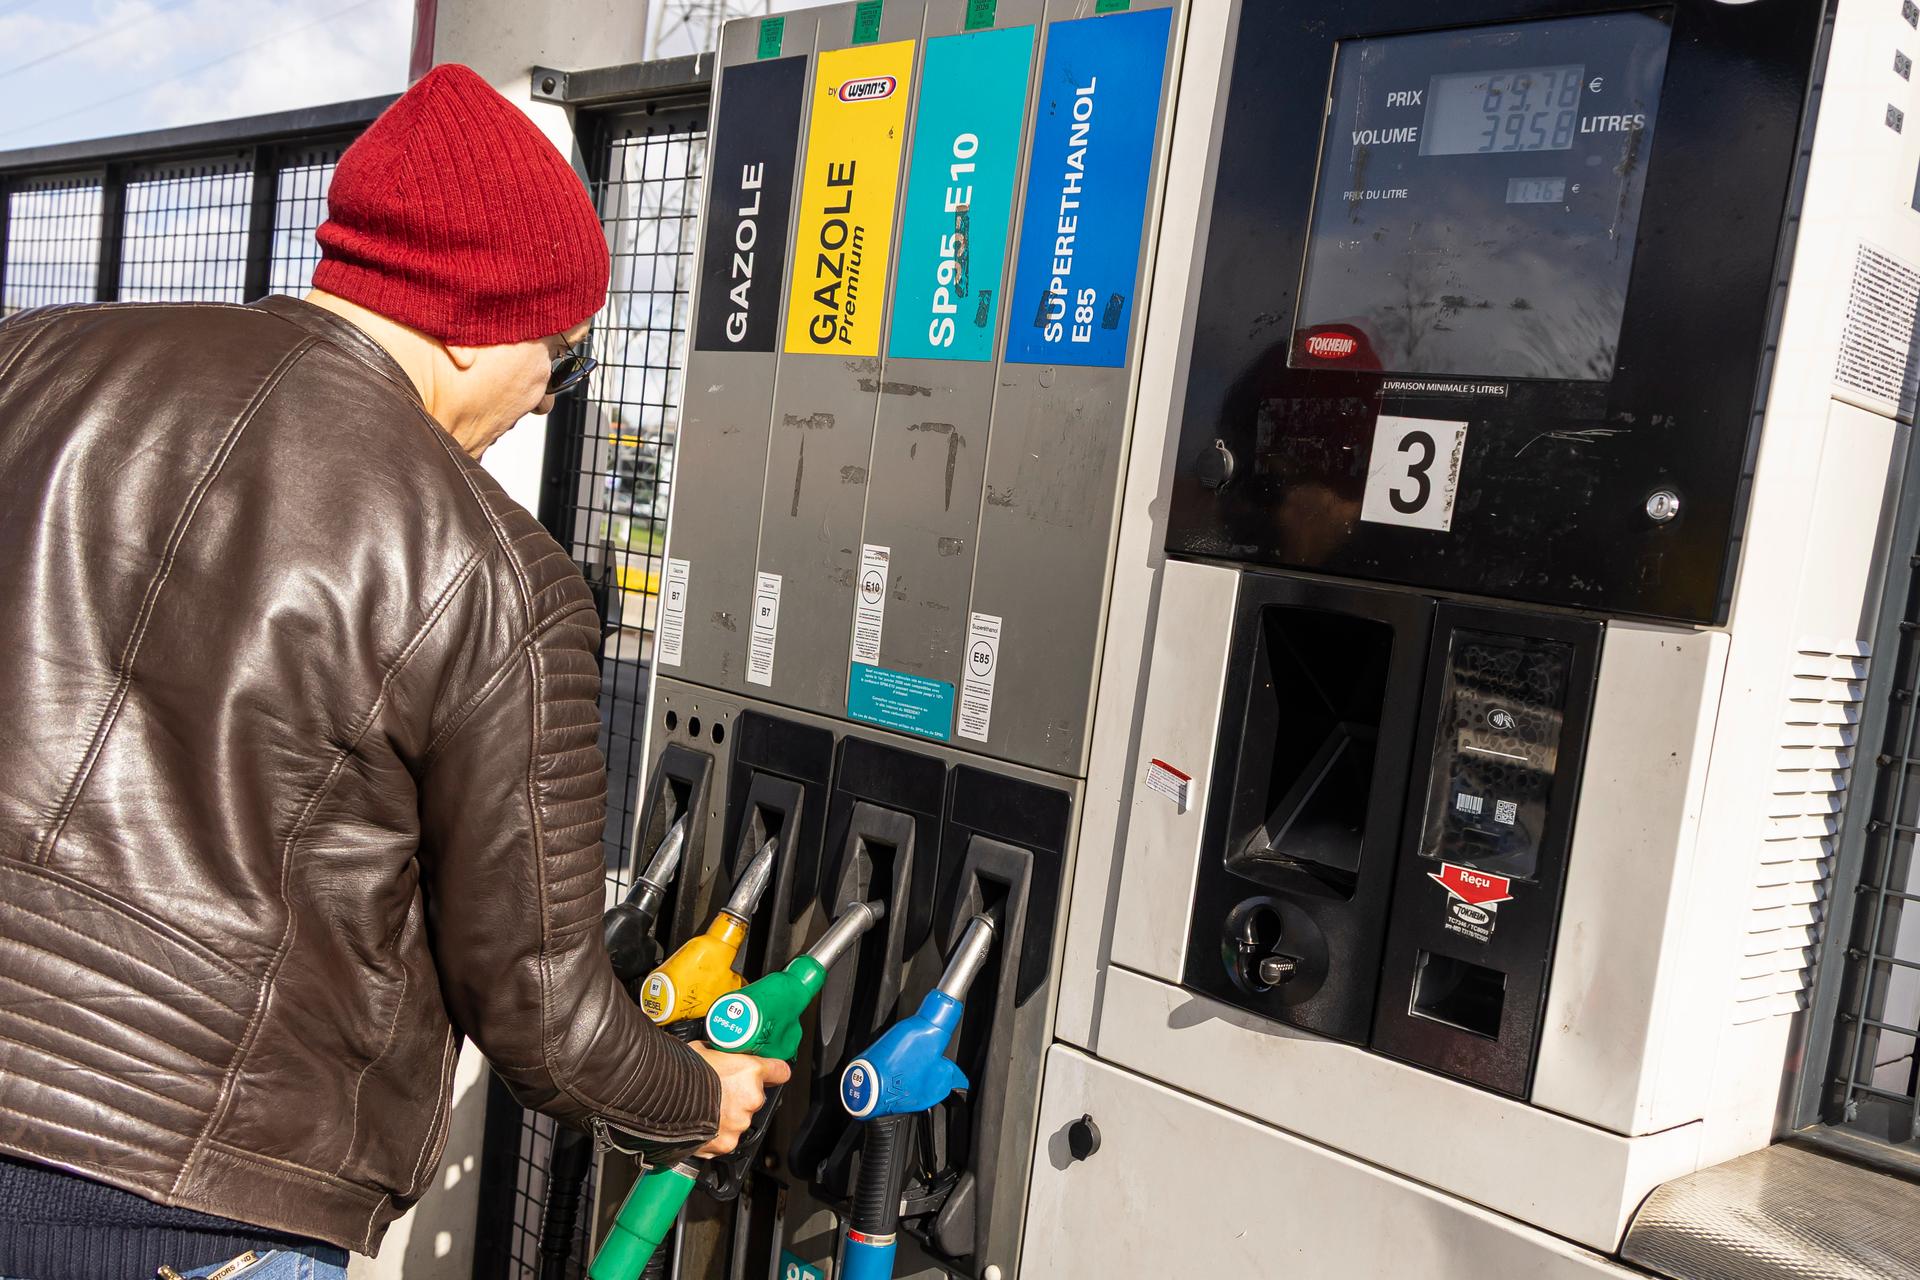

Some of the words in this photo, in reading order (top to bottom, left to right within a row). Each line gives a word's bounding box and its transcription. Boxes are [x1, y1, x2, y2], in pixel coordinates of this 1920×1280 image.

[828, 86, 838, 97] by
[1386, 90, 1424, 107] PRIX
[1588, 77, 1604, 93] €
[1351, 127, 1418, 146] VOLUME
[1580, 114, 1646, 133] LITRES
[1343, 190, 1364, 201] PRIX
[1366, 190, 1381, 200] DU
[1382, 188, 1408, 199] LITRE
[1571, 183, 1581, 194] €
[1043, 76, 1097, 343] SUPERETHANOL
[726, 162, 764, 343] GAZOLE
[809, 160, 856, 345] GAZOLE
[838, 225, 865, 345] Premium
[1071, 287, 1097, 343] E85
[1309, 336, 1353, 353] TOKHEIM
[1383, 381, 1425, 391] LIVRAISON
[1426, 383, 1468, 393] MINIMALE
[1469, 384, 1475, 393] 5
[1476, 385, 1505, 395] LITRES
[1388, 430, 1436, 514] 3
[865, 581, 880, 593] E10
[671, 591, 681, 601] B7
[761, 607, 771, 617] B7
[973, 651, 990, 665] E85
[1460, 871, 1490, 888] Reçu
[1457, 905, 1485, 922] TOKHEIM
[644, 998, 663, 1011] DIESEL
[728, 1005, 742, 1015] E10
[713, 1015, 743, 1034] SP95-E10
